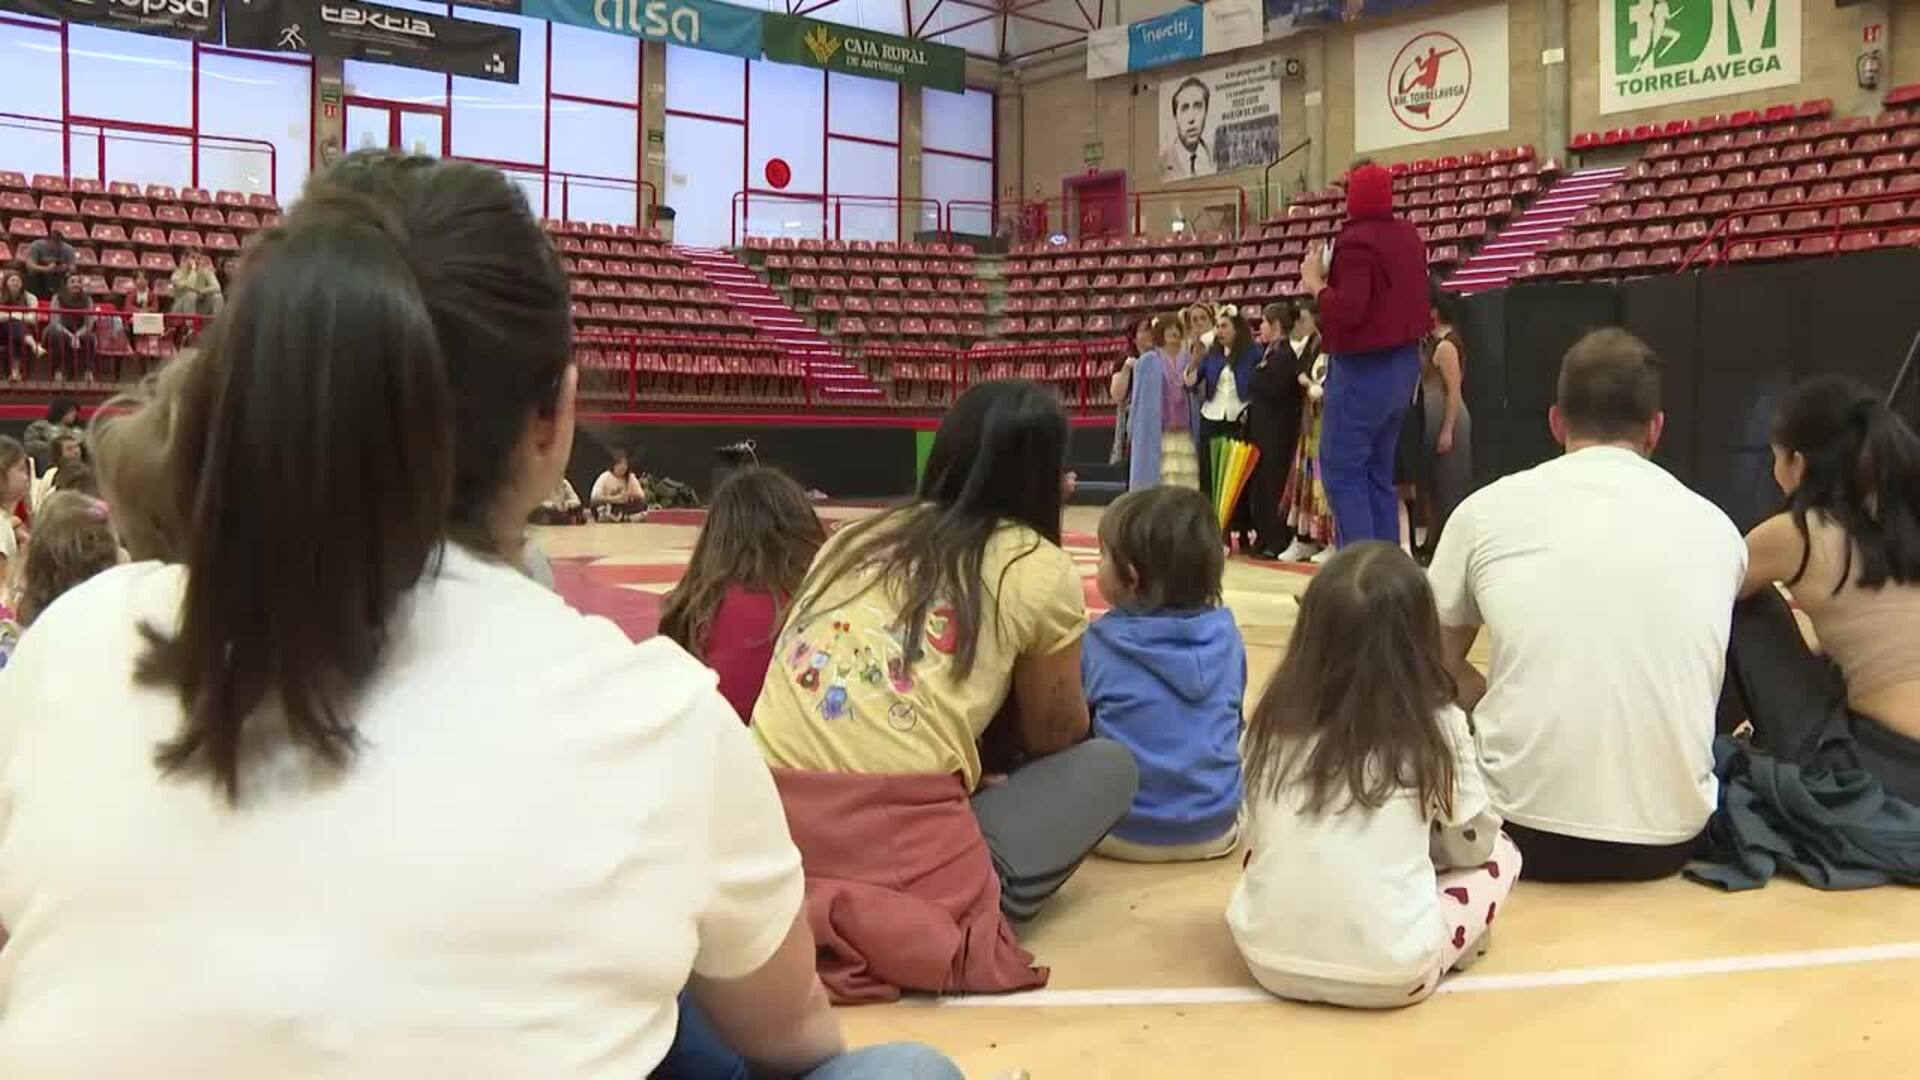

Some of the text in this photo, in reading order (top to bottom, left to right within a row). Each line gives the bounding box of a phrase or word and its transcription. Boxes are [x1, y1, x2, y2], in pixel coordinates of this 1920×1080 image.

[594, 0, 699, 44] alsa
[844, 38, 928, 65] CAJA RURAL
[846, 55, 859, 67] DE
[1616, 55, 1782, 96] TORRELAVEGA
[1410, 84, 1465, 105] TORRELAVEGA
